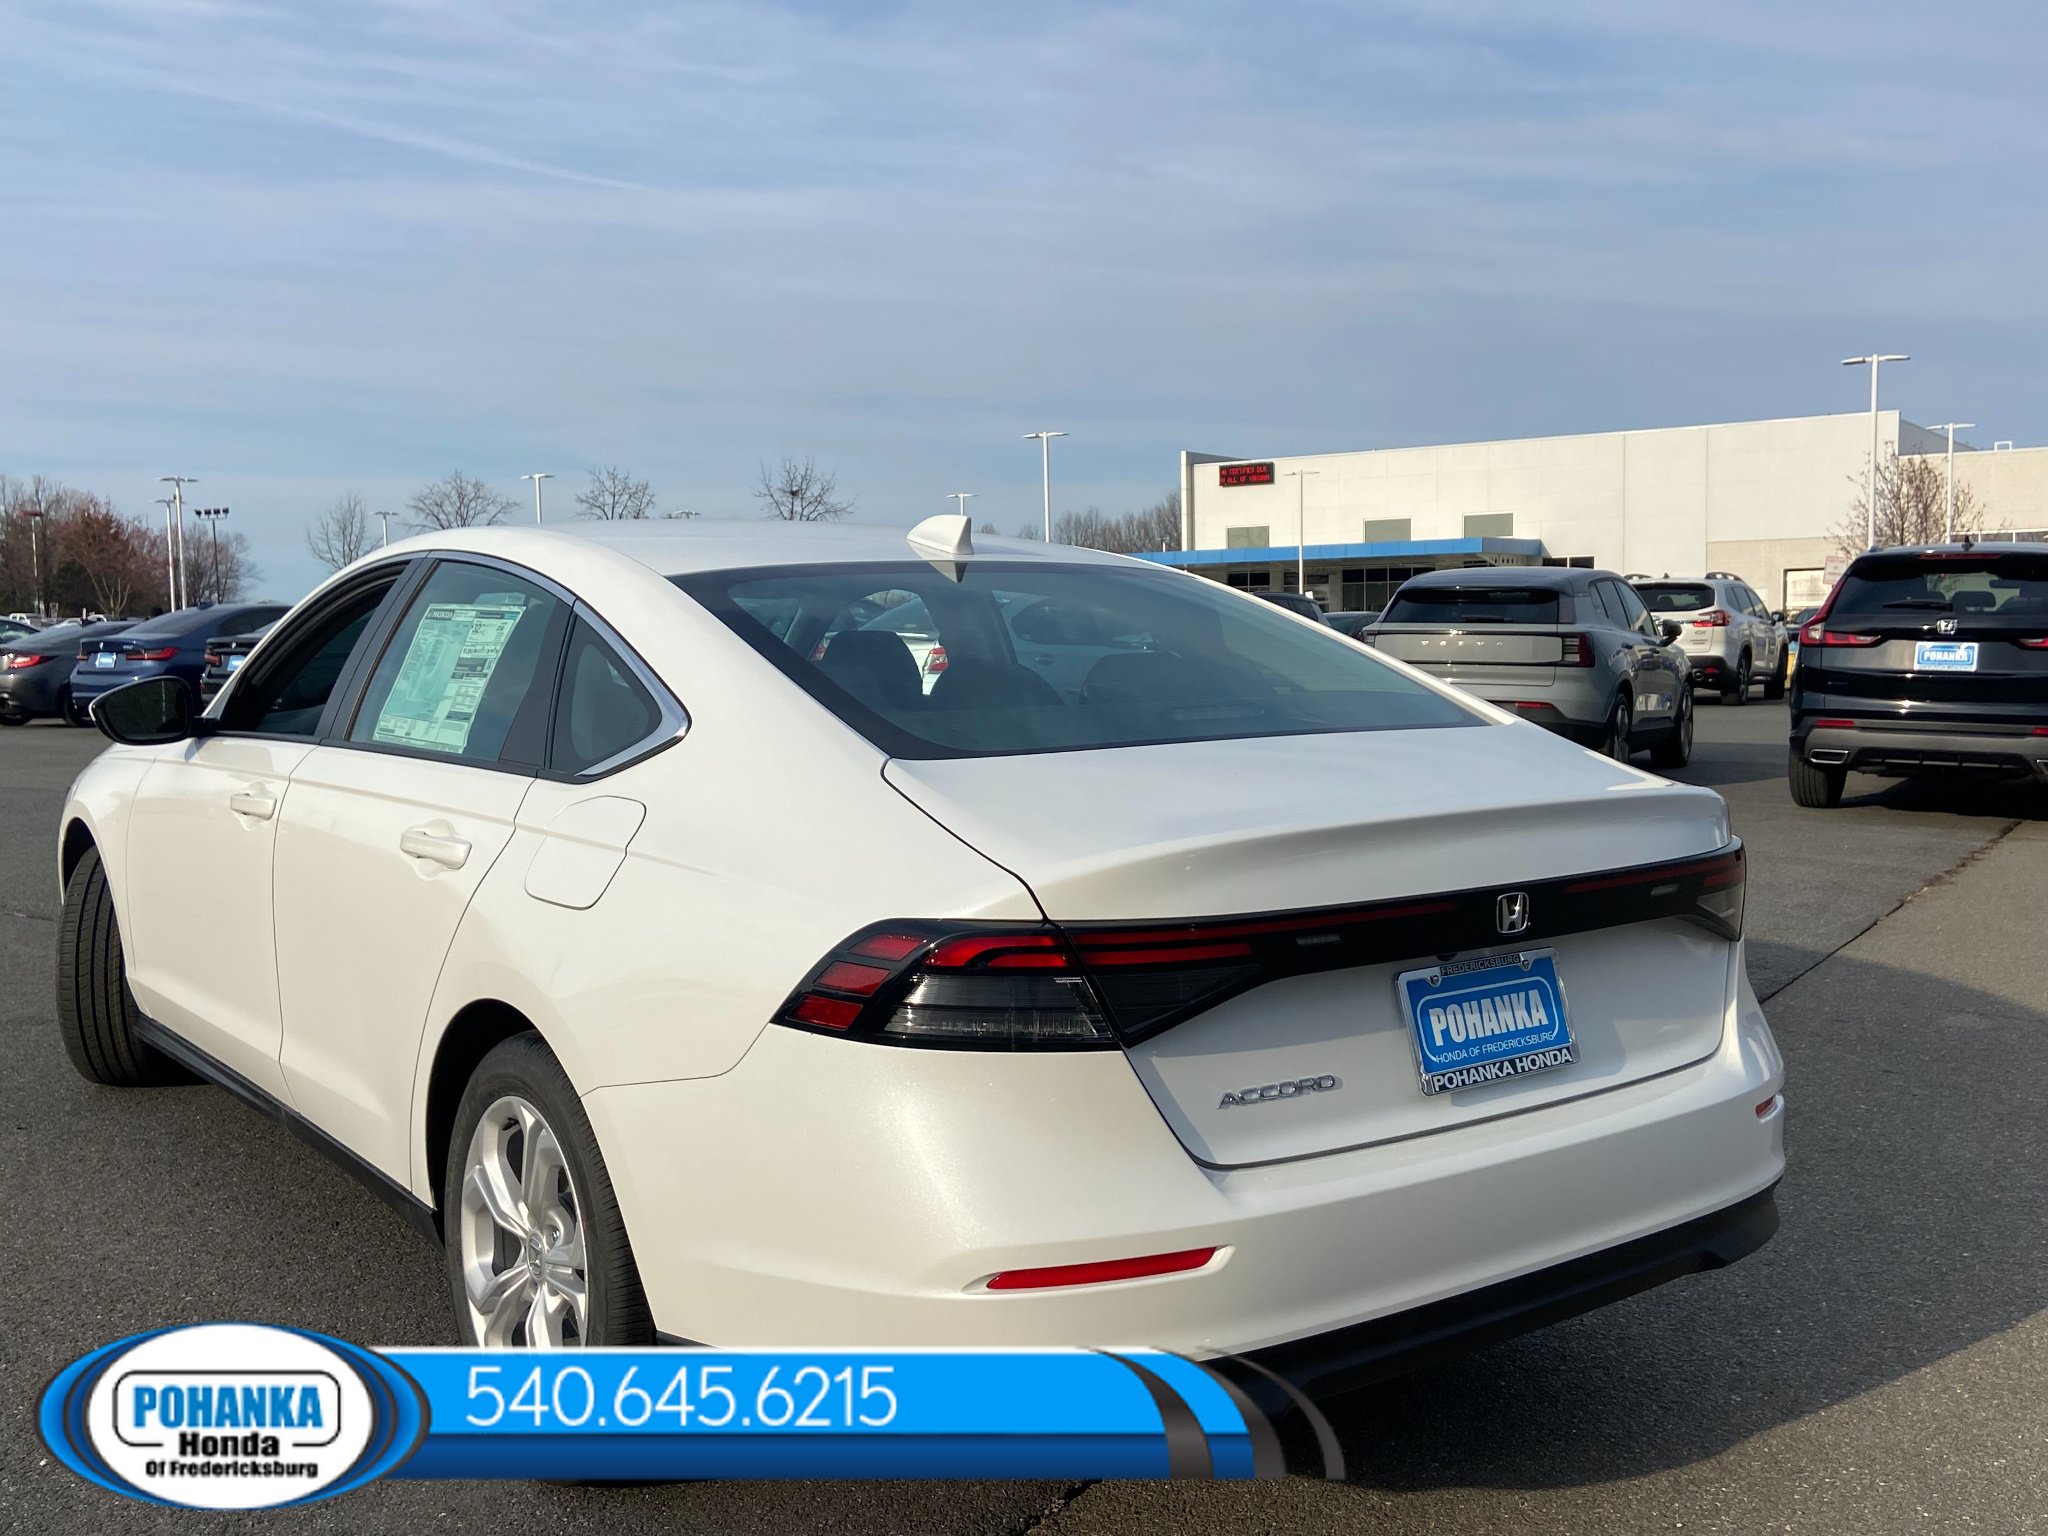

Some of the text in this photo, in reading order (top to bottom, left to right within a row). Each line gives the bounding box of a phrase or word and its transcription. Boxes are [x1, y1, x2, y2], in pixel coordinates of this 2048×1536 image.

[1440, 954, 1521, 976] FREDERICKSBURG
[1428, 989, 1549, 1046] POHANKA
[1436, 1030, 1555, 1064] HONDA OF FREDERICKSBURG
[1433, 1048, 1573, 1092] POHANKA HONDA
[1217, 1075, 1336, 1109] ACCORD
